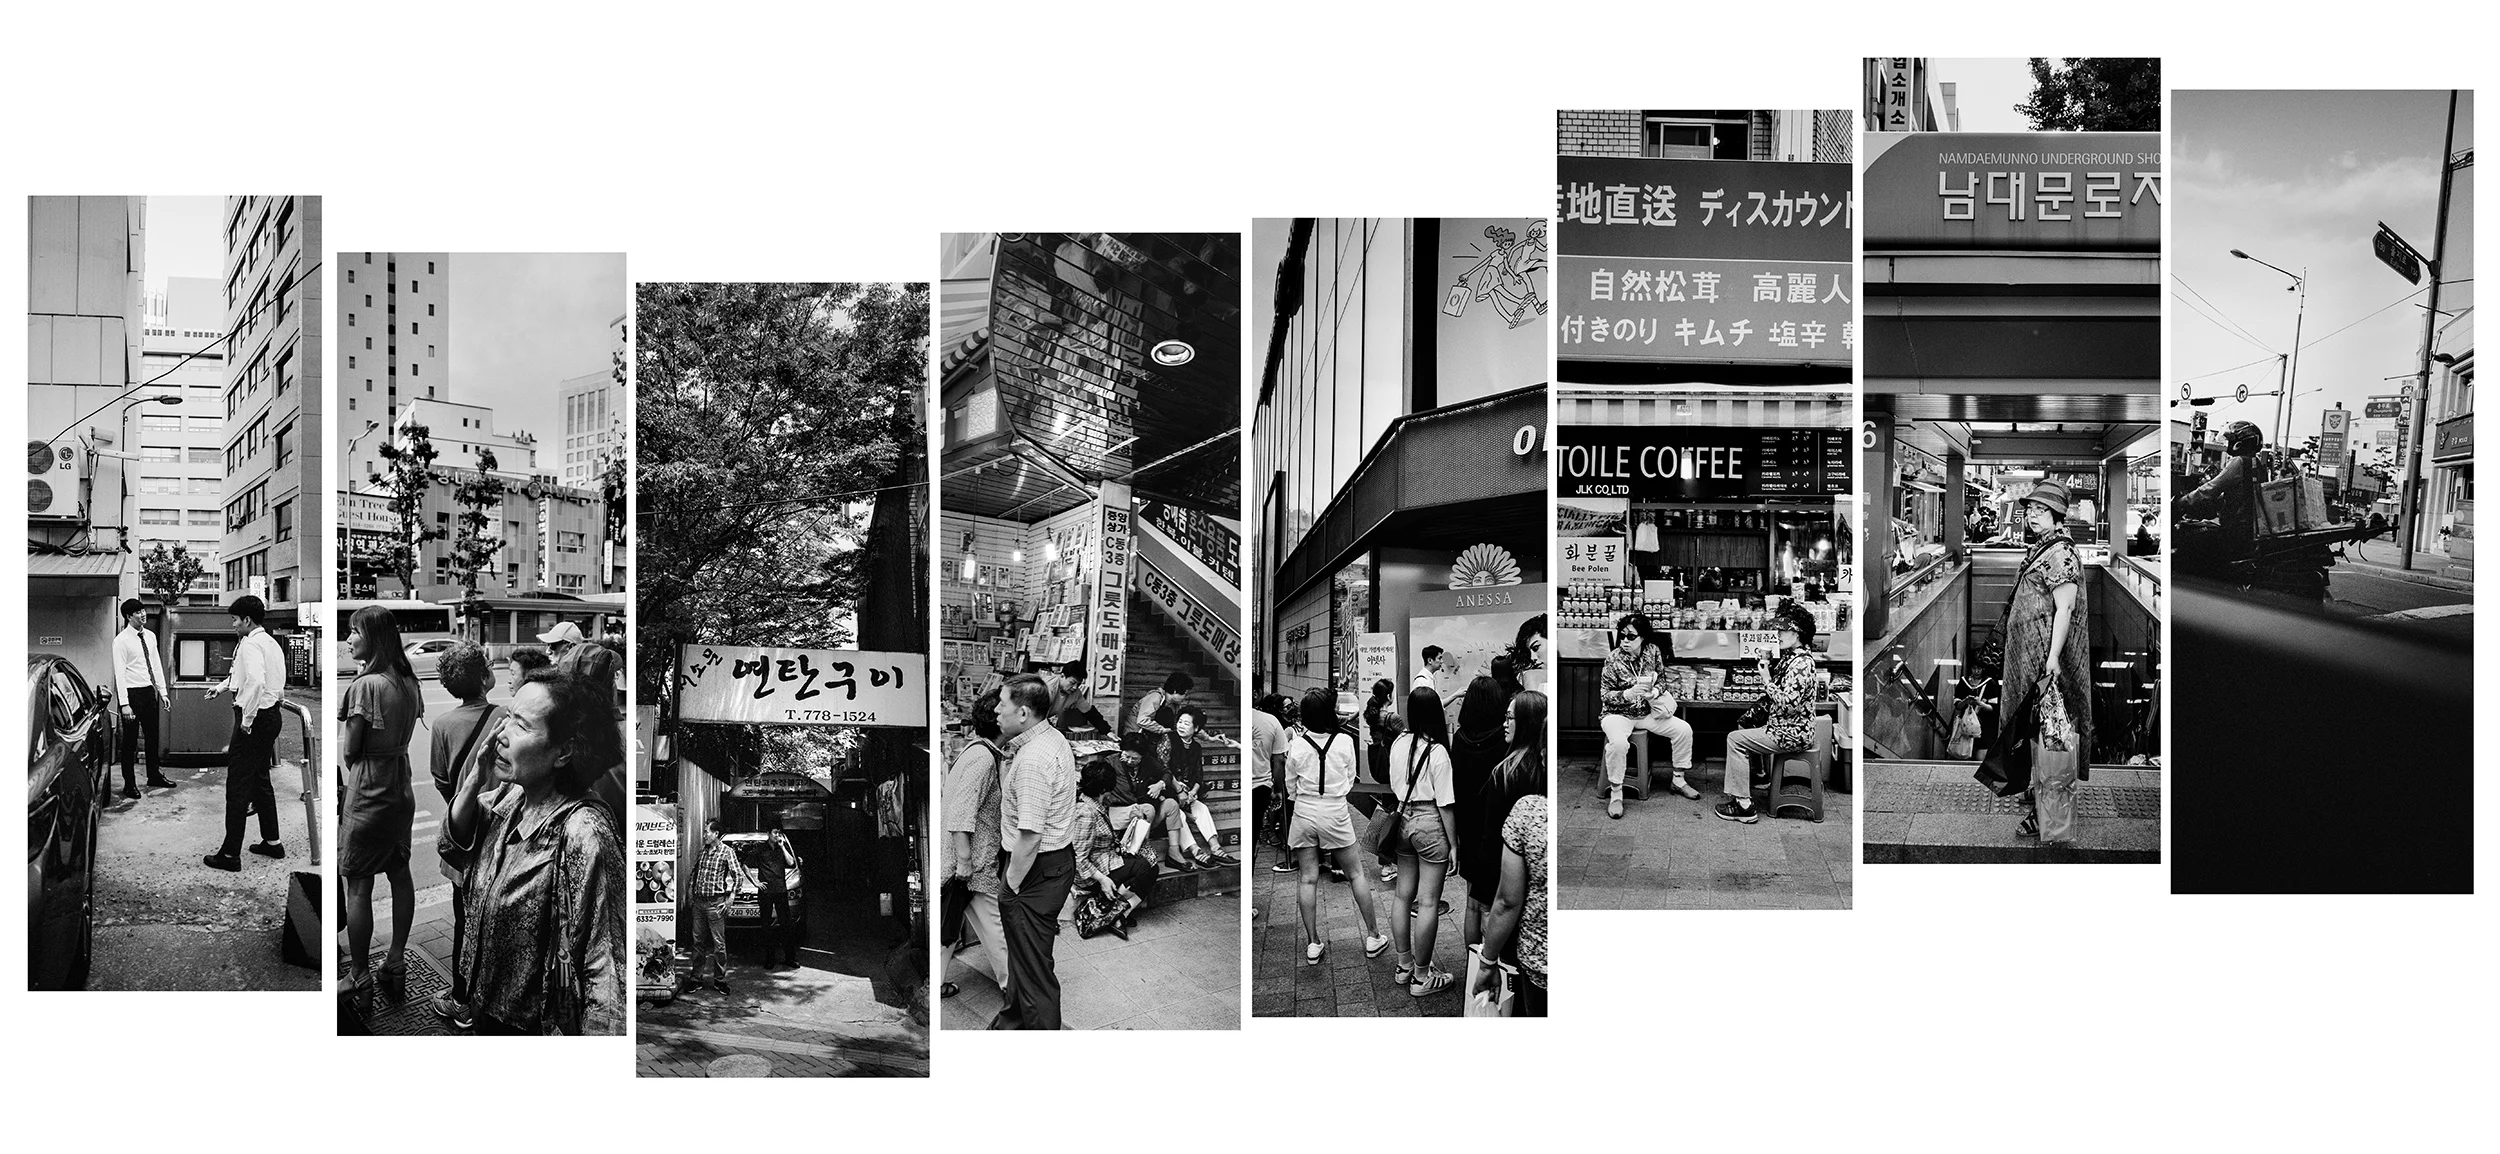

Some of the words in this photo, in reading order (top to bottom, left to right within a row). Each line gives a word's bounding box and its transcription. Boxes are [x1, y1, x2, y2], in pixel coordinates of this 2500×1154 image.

[1939, 153, 2038, 165] NAMDAEMUNNO
[2042, 153, 2134, 165] UNDERGROUND
[1590, 268, 1721, 303] 自然松茸
[1753, 272, 1852, 304] 高麗人
[1561, 315, 1657, 345] 付きのり
[1675, 317, 1753, 346] キムチ
[1769, 319, 1827, 349] 塩辛
[1863, 420, 1877, 448] 6
[1557, 445, 1630, 478] TOILE
[1576, 485, 1593, 495] JLK
[1107, 510, 1128, 523] 중앙
[1107, 522, 1127, 534] 상가
[1105, 551, 1125, 566] 3층
[1571, 565, 1586, 573] Bee
[1588, 565, 1609, 573] Polen
[1456, 592, 1512, 608] ANESSA
[1098, 571, 1122, 692] 그릇도매상가
[733, 654, 904, 700] 연탄구이
[785, 709, 877, 722] T.778-1524
